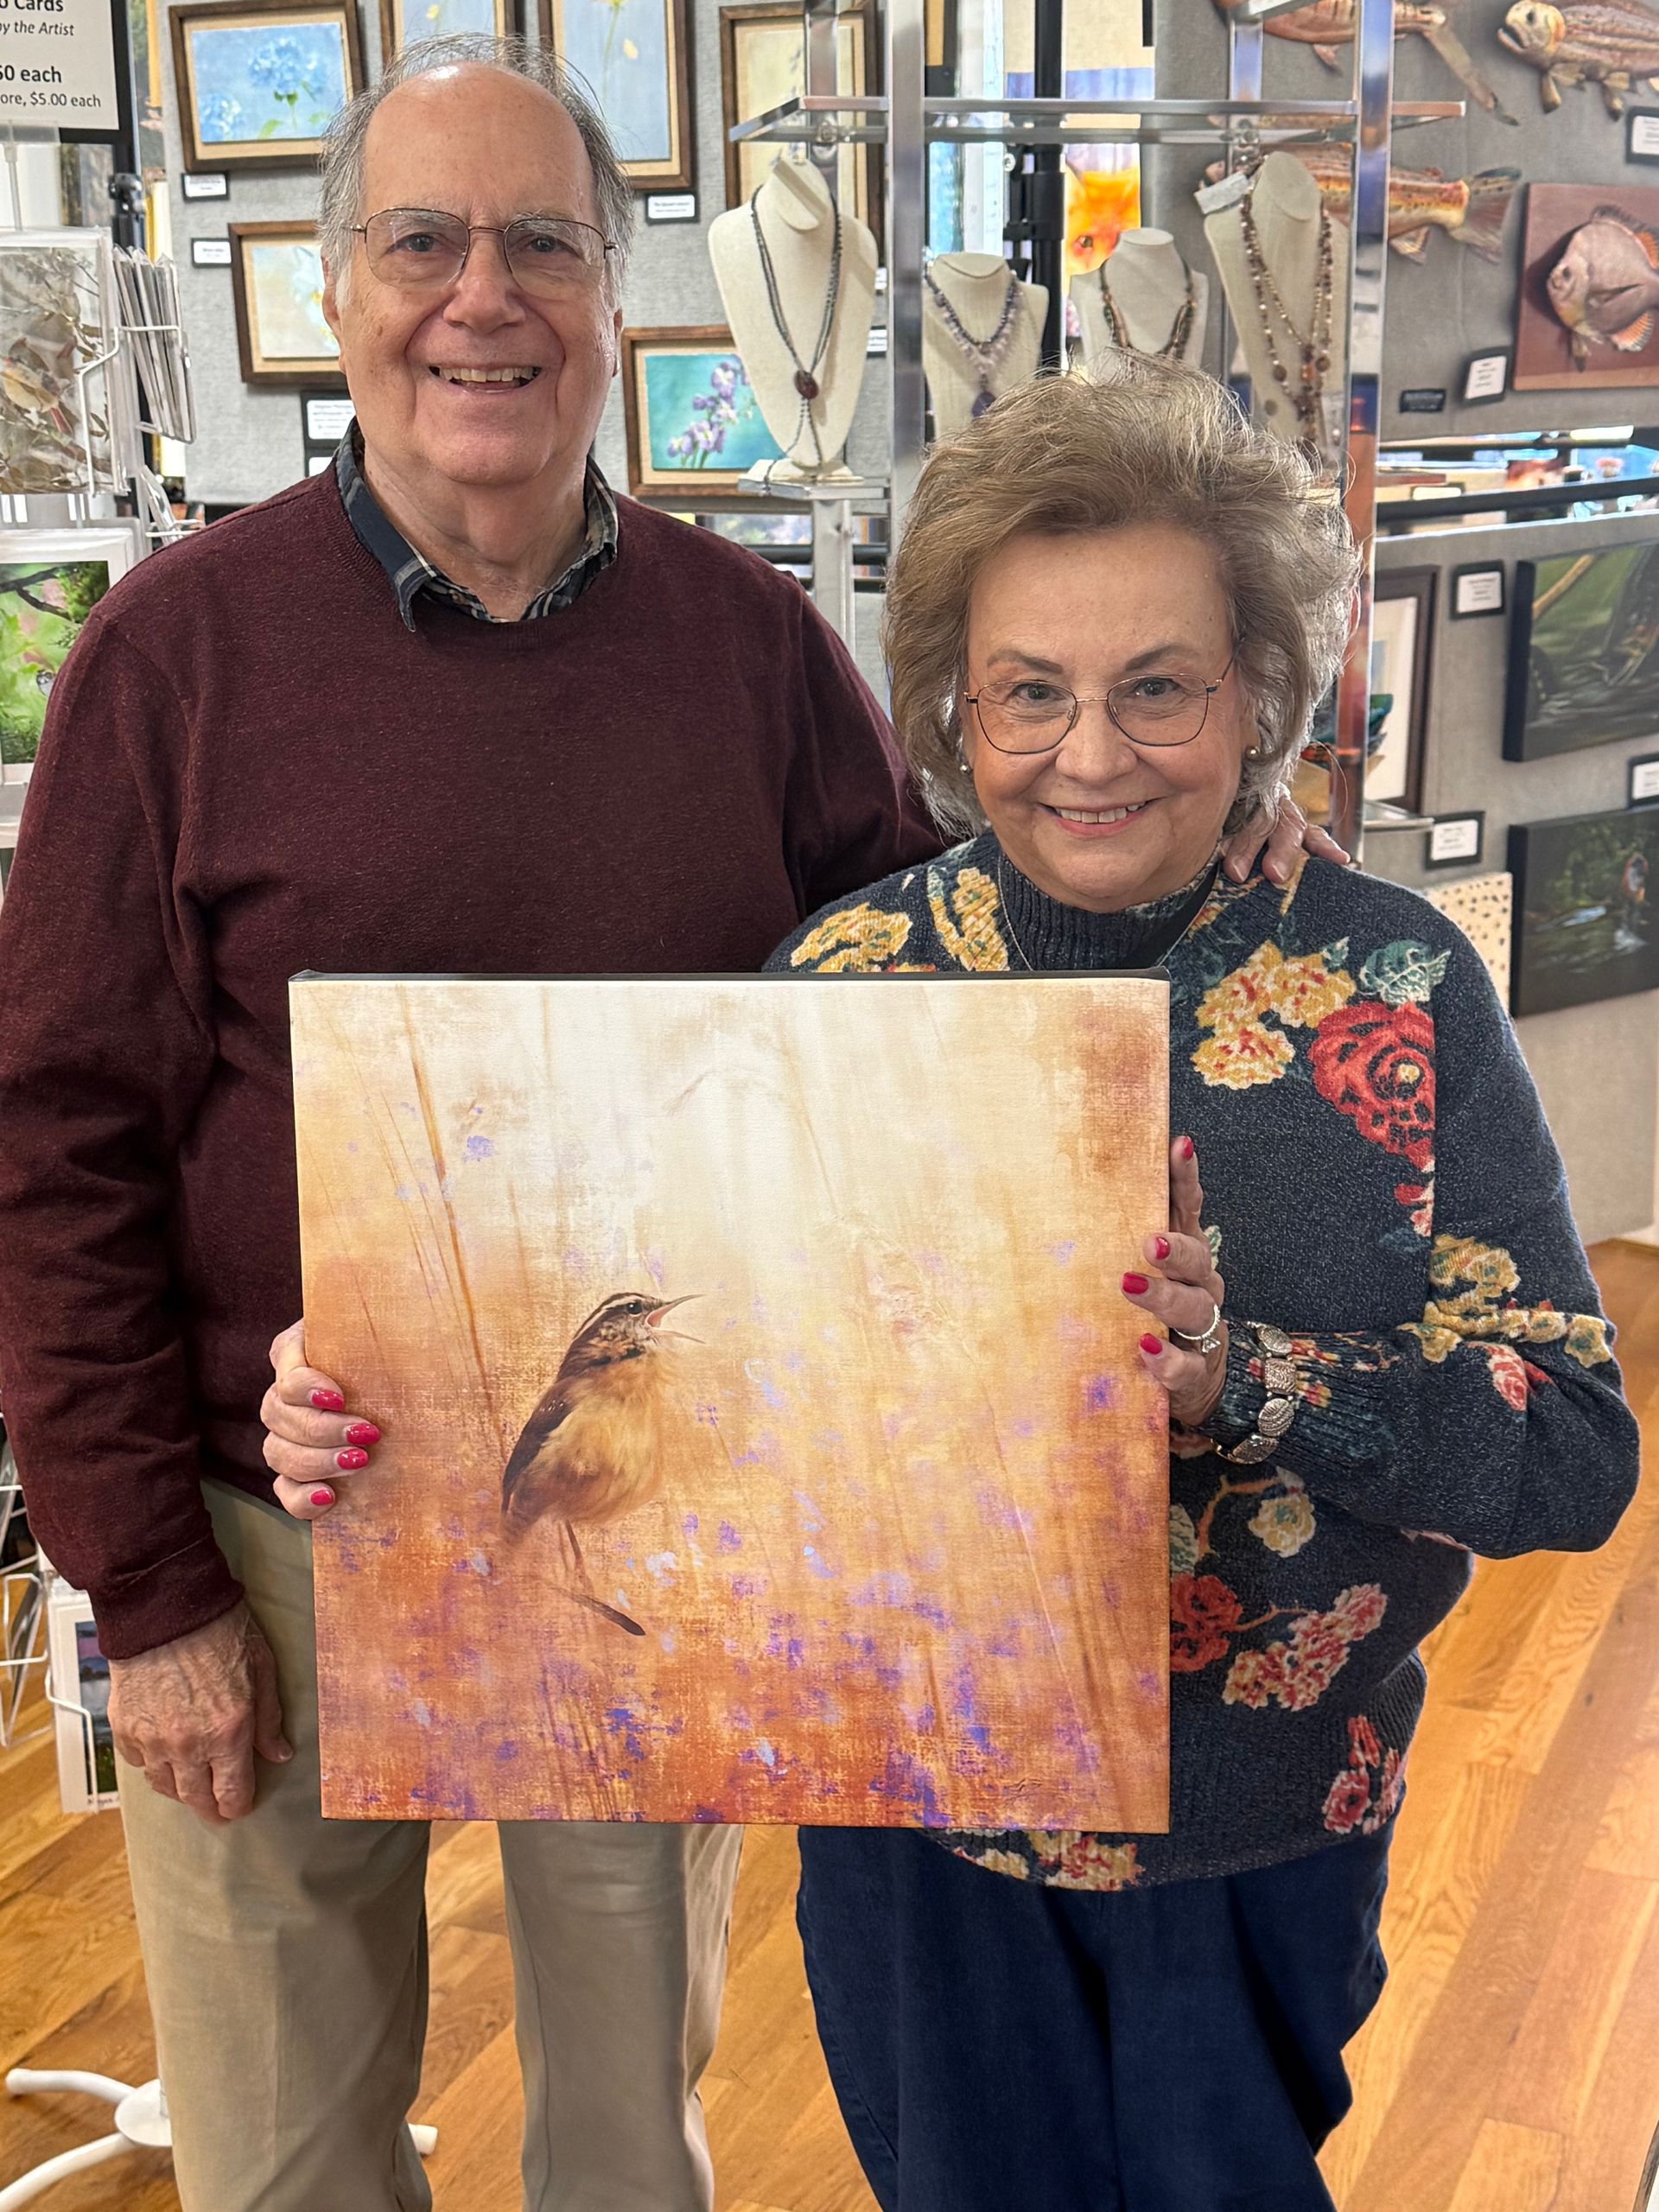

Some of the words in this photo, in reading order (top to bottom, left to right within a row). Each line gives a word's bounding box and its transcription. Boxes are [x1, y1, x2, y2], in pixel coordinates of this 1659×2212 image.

[15, 0, 64, 12] Cards
[14, 20, 35, 34] the
[38, 22, 74, 36] Artist
[21, 66, 62, 83] each
[29, 91, 67, 106] $5.00
[71, 94, 102, 108] each
